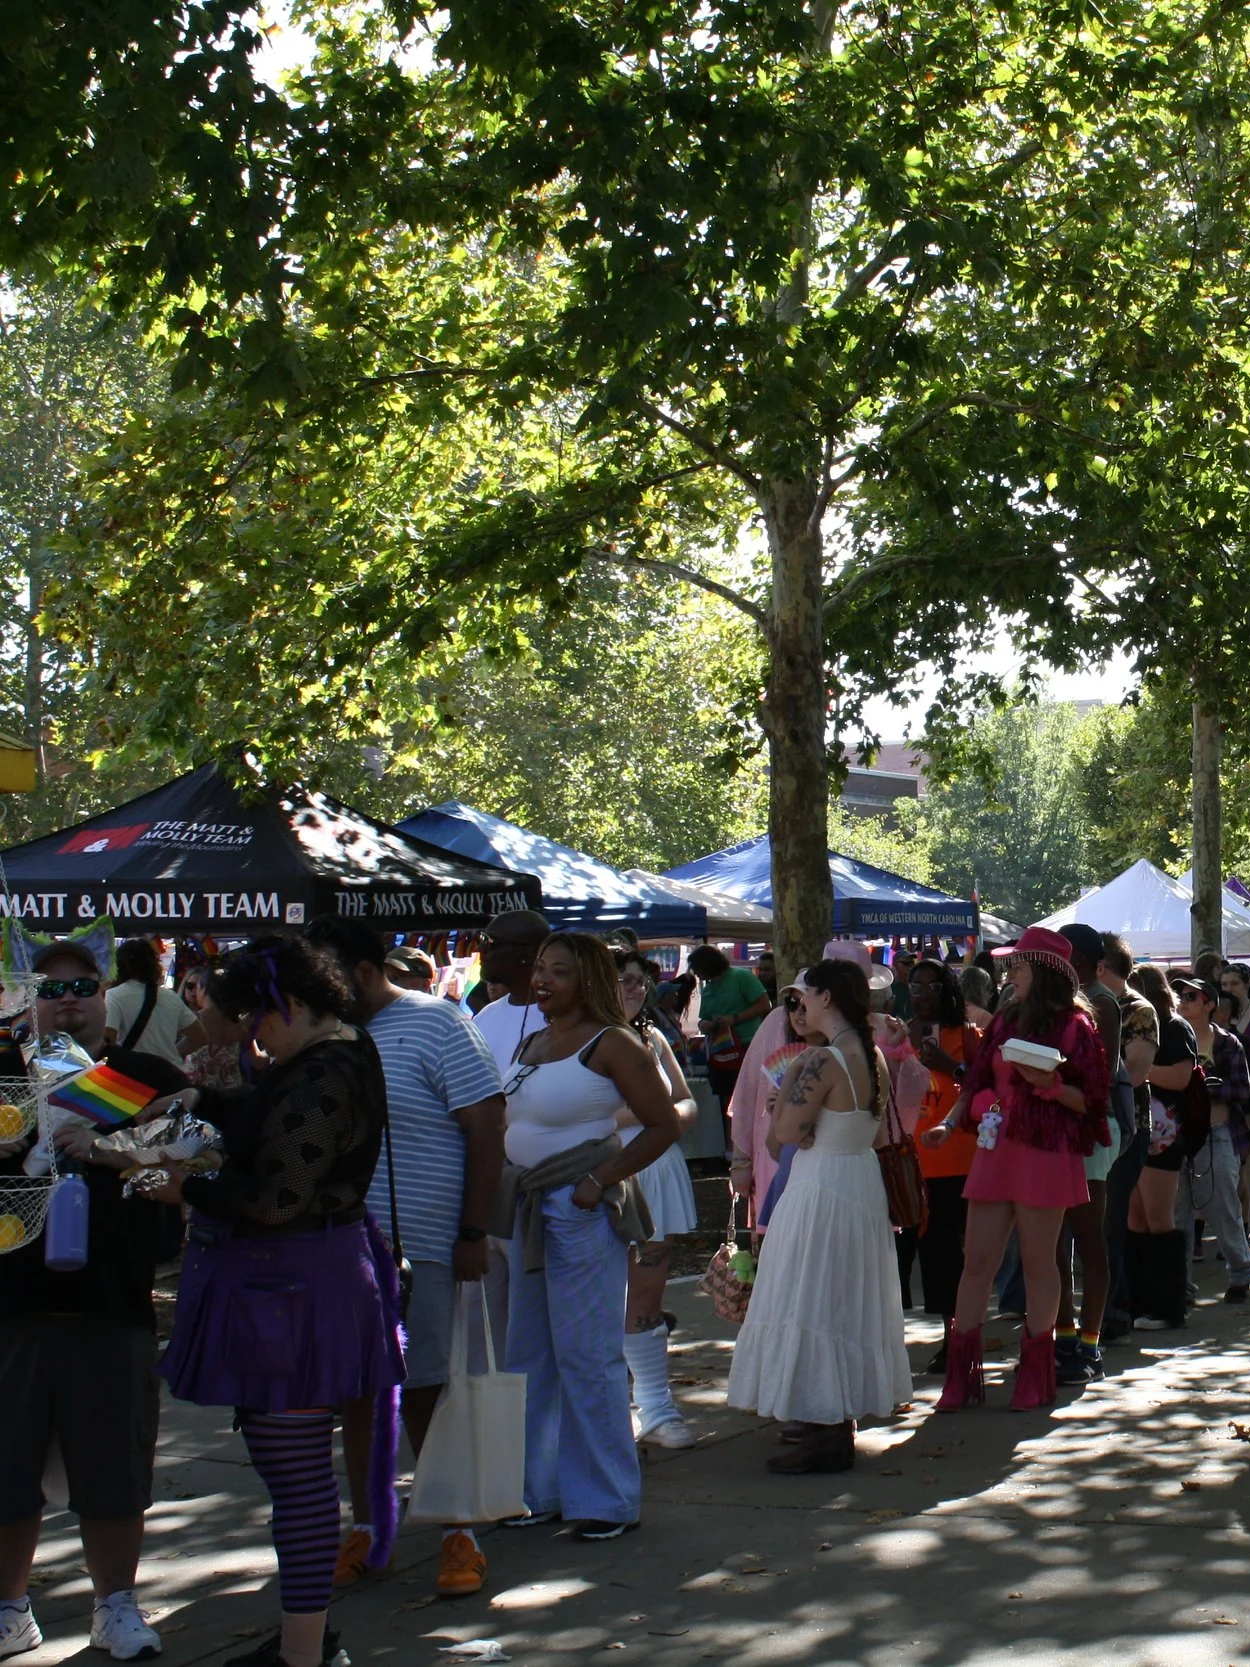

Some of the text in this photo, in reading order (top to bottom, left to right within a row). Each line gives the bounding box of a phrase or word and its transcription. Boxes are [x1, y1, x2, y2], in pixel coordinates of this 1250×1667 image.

[153, 821, 254, 835] THE MATT &
[140, 830, 253, 845] MOLLY TEAM
[0, 893, 67, 918] MATT
[78, 894, 96, 918] &
[106, 893, 195, 918] MOLLY
[203, 892, 280, 918] TEAM
[335, 891, 529, 916] THE MATT & MOLLY TEAM
[861, 912, 879, 924] YMCA
[880, 912, 888, 923] OF
[888, 912, 917, 924] WESTERN
[917, 913, 938, 925] NORTH
[938, 914, 966, 926] CAROLINA
